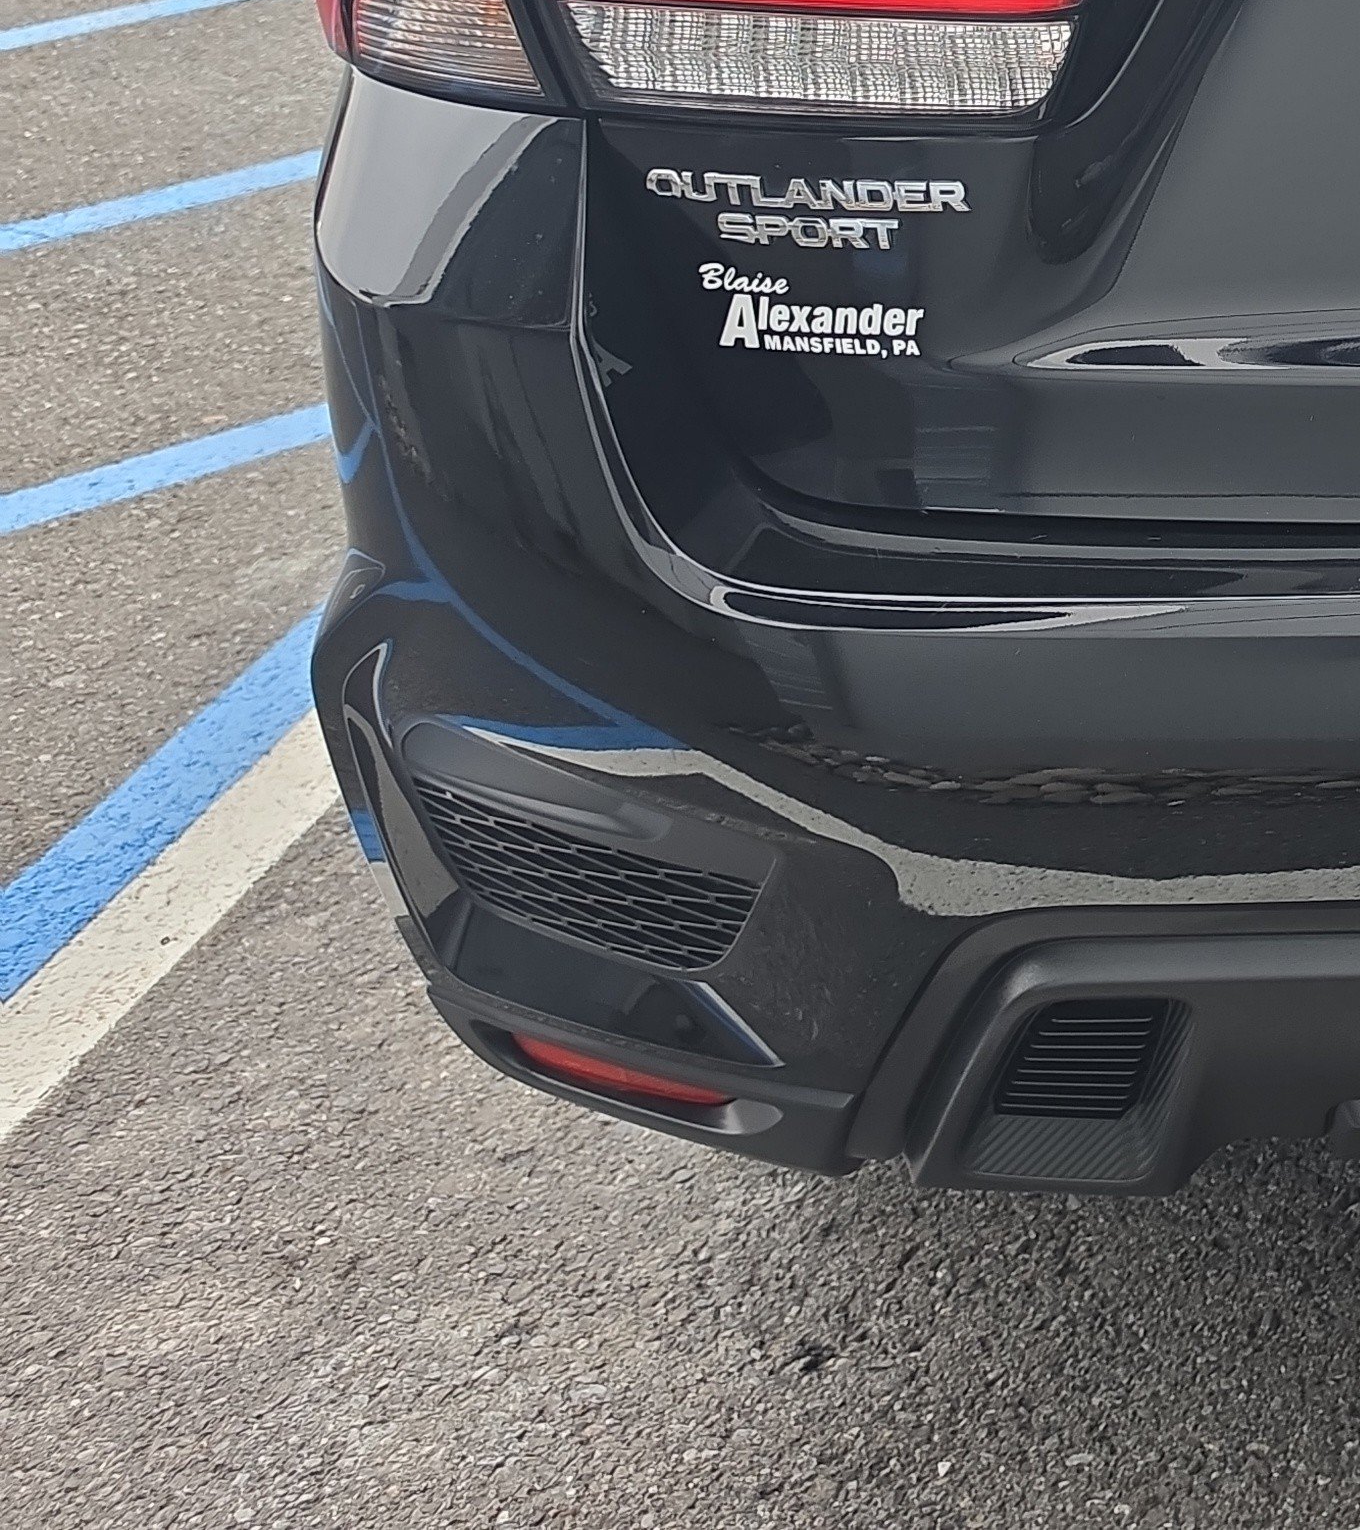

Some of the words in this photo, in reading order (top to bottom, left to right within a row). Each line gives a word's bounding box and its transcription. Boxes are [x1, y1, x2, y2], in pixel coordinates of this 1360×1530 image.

[645, 168, 973, 213] OUTLANDER
[717, 212, 900, 250] SPORT
[698, 263, 790, 295] Blaise
[719, 293, 925, 349] Alexander
[764, 334, 888, 359] MANSFIELD,
[893, 338, 921, 357] PA
